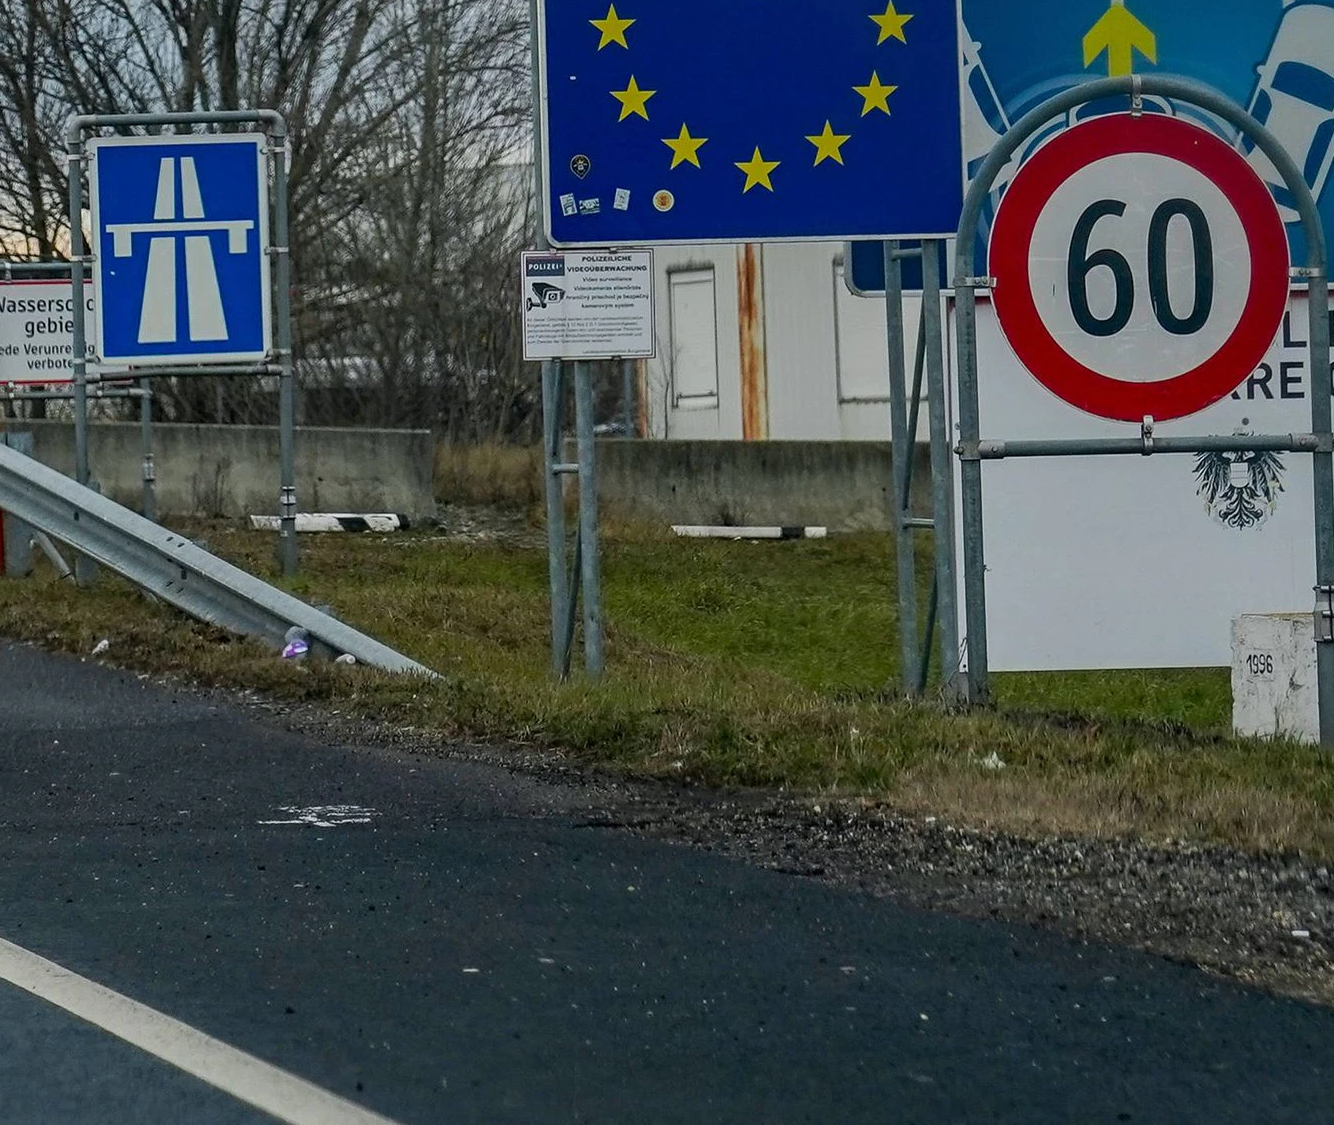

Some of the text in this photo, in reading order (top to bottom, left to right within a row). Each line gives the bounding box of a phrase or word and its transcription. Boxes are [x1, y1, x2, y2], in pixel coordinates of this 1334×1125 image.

[1067, 198, 1214, 337] 60
[25, 316, 74, 338] gebie
[27, 357, 73, 370] verbote
[1246, 653, 1274, 675] 1996
